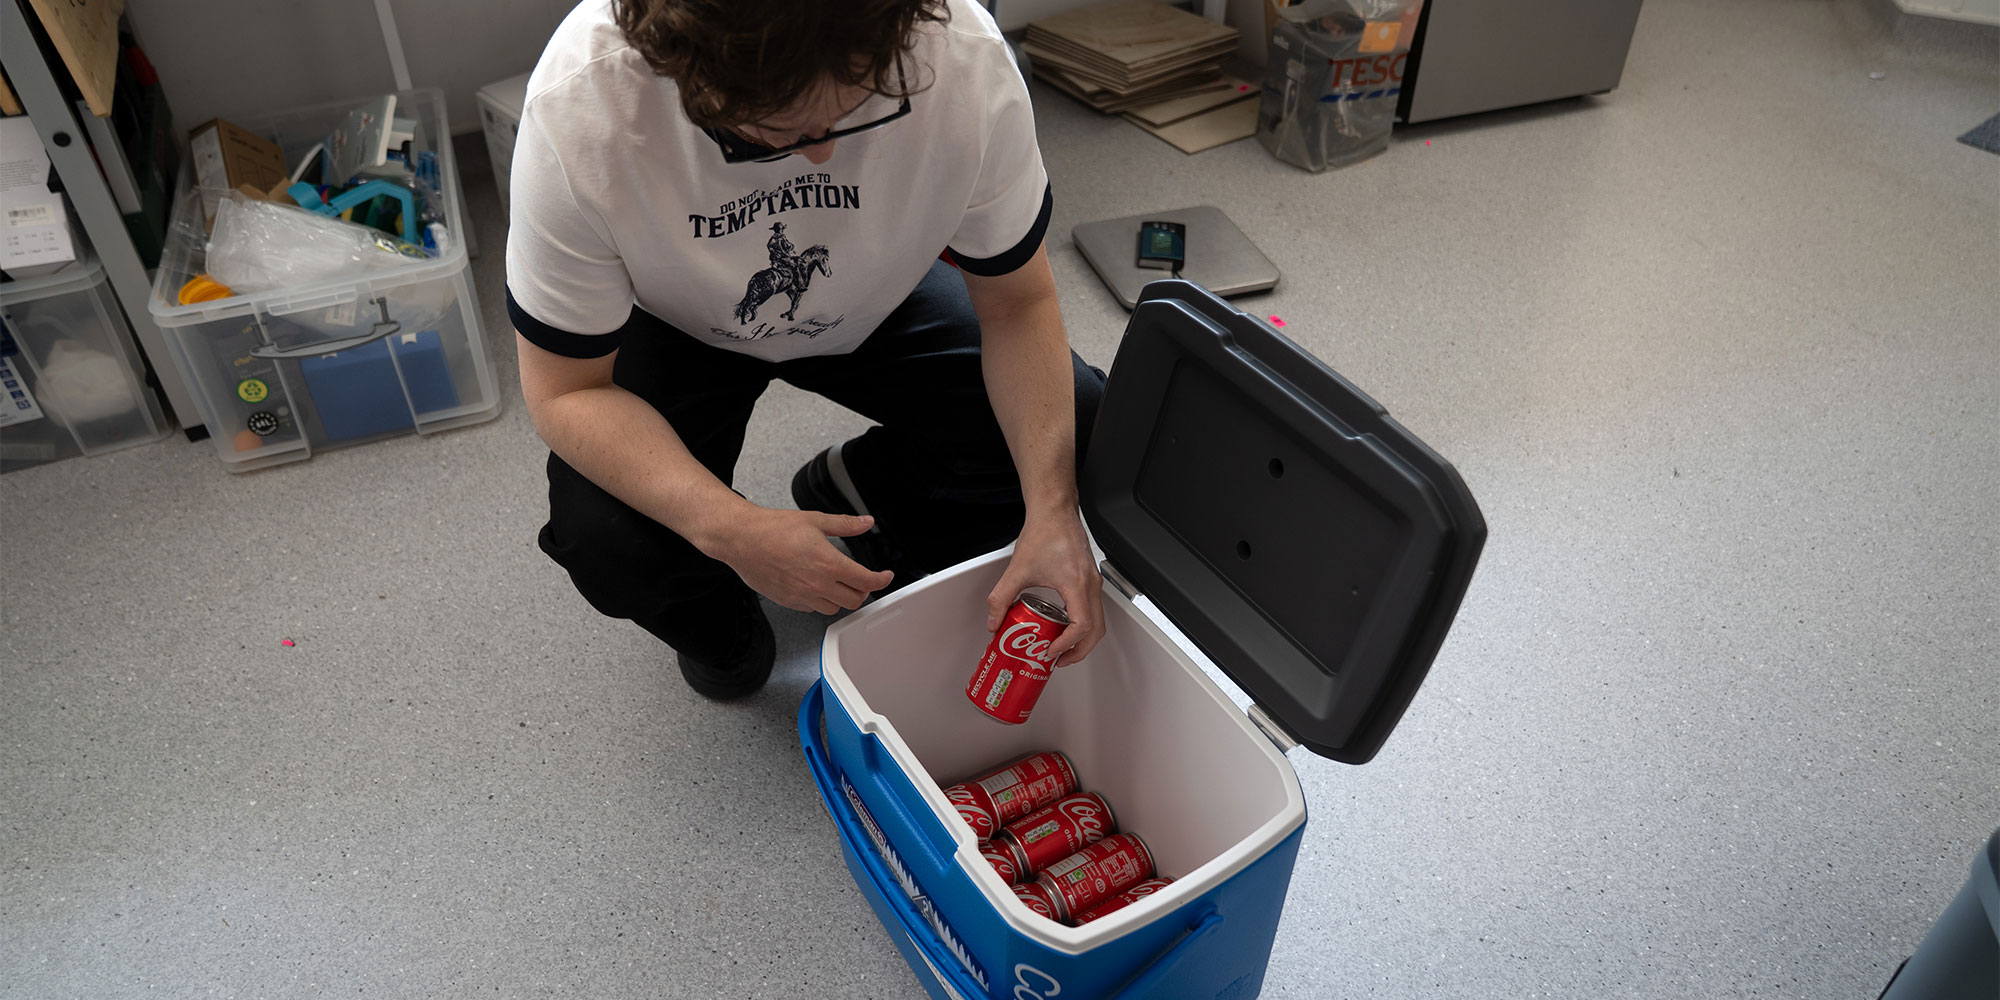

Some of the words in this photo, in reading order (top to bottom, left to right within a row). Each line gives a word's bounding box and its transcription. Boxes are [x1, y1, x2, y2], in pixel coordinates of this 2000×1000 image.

[689, 184, 860, 238] TEMPTATION
[720, 201, 735, 215] DO
[738, 190, 758, 207] NOT
[795, 174, 815, 185] ME
[817, 173, 831, 184] TO
